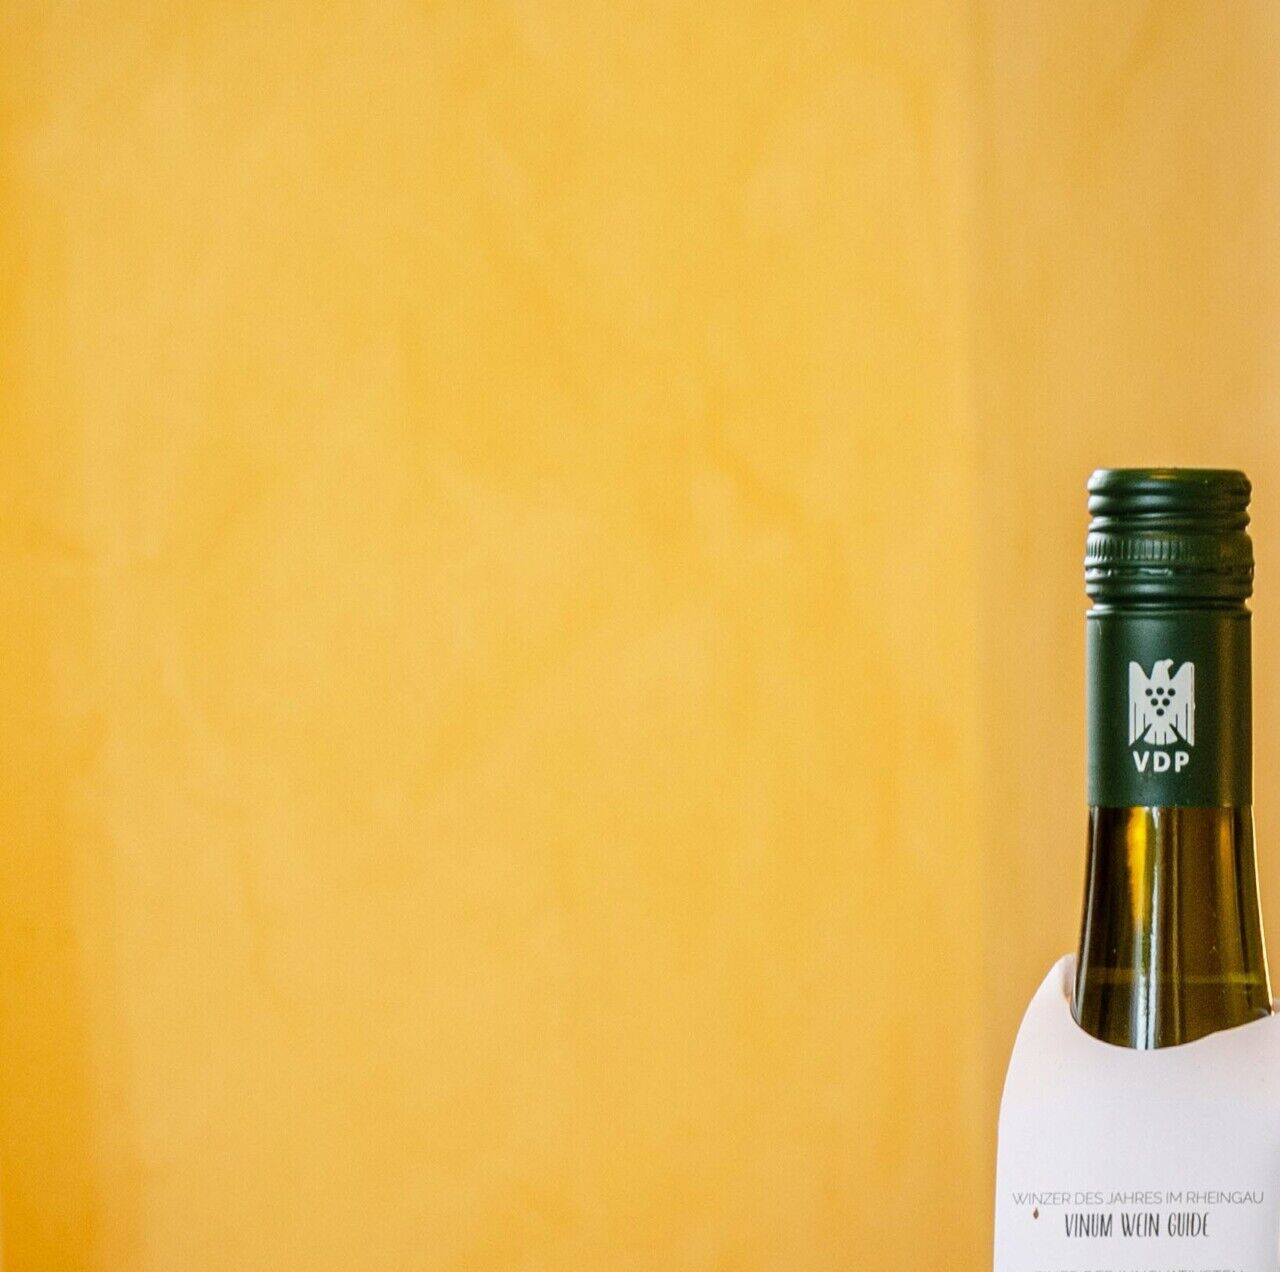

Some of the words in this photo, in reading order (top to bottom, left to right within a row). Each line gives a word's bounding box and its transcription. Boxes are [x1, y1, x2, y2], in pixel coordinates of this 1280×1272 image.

[1132, 750, 1190, 772] VDP
[1012, 1192, 1071, 1205] WINZER
[1074, 1192, 1103, 1205] DES
[1106, 1191, 1163, 1205] JAHRES
[1166, 1191, 1183, 1204] IM
[1187, 1191, 1265, 1204] RHEINGAU
[1065, 1213, 1113, 1238] VINUM
[1121, 1212, 1160, 1237] WEIN
[1167, 1212, 1210, 1237] GUIDE
